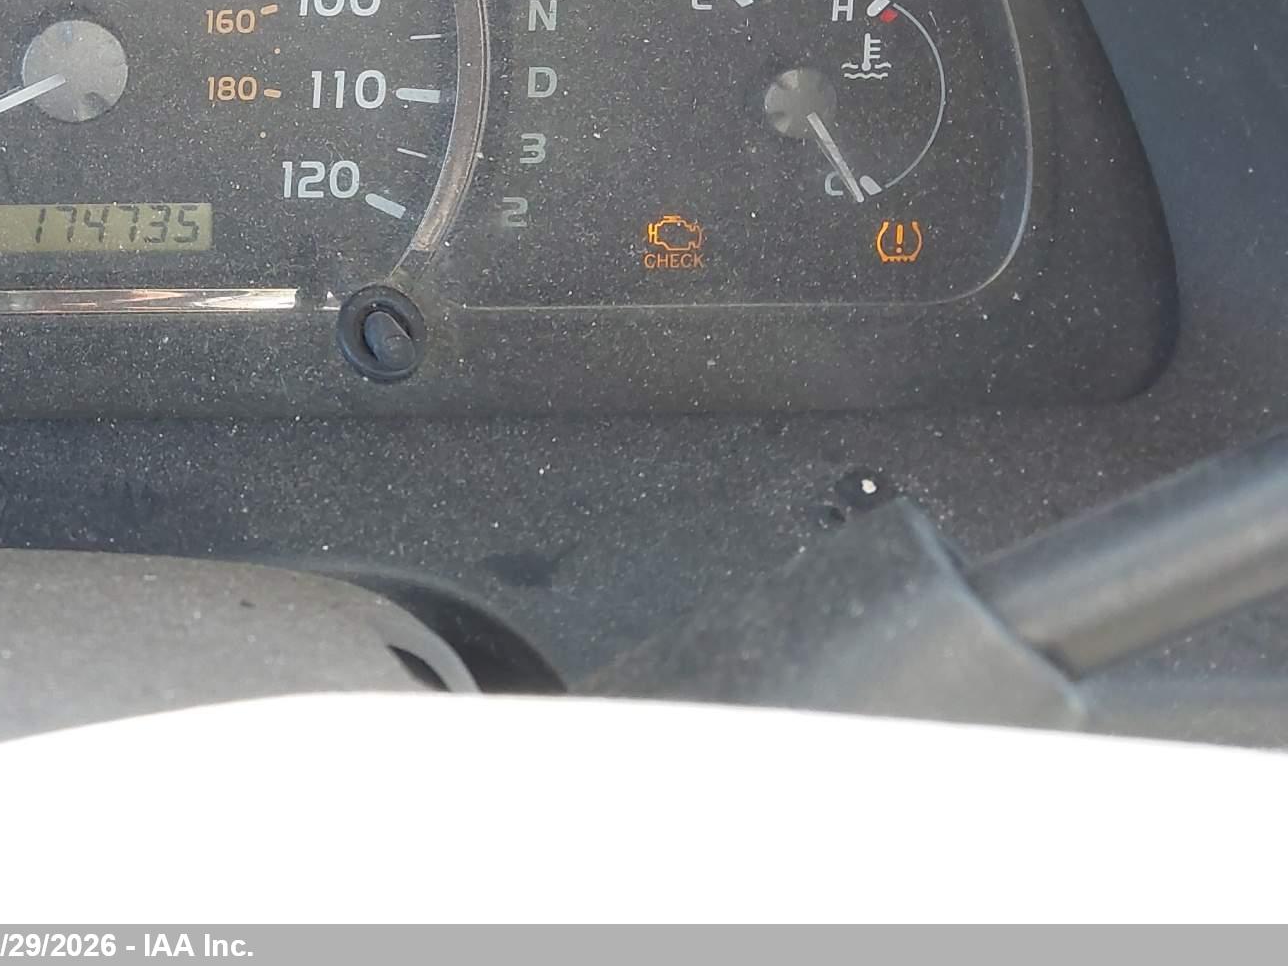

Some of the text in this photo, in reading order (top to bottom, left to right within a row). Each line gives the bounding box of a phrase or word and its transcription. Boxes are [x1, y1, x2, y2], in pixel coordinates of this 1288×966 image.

[206, 9, 255, 34] 160
[527, 0, 558, 31] N
[206, 76, 258, 101] 180
[311, 70, 386, 109] 110
[527, 67, 558, 97] D
[519, 134, 546, 164] 3
[282, 161, 360, 199] 120
[824, 172, 844, 196] C
[34, 206, 199, 243] 174735
[501, 197, 528, 226] 2
[644, 253, 703, 269] CHECK
